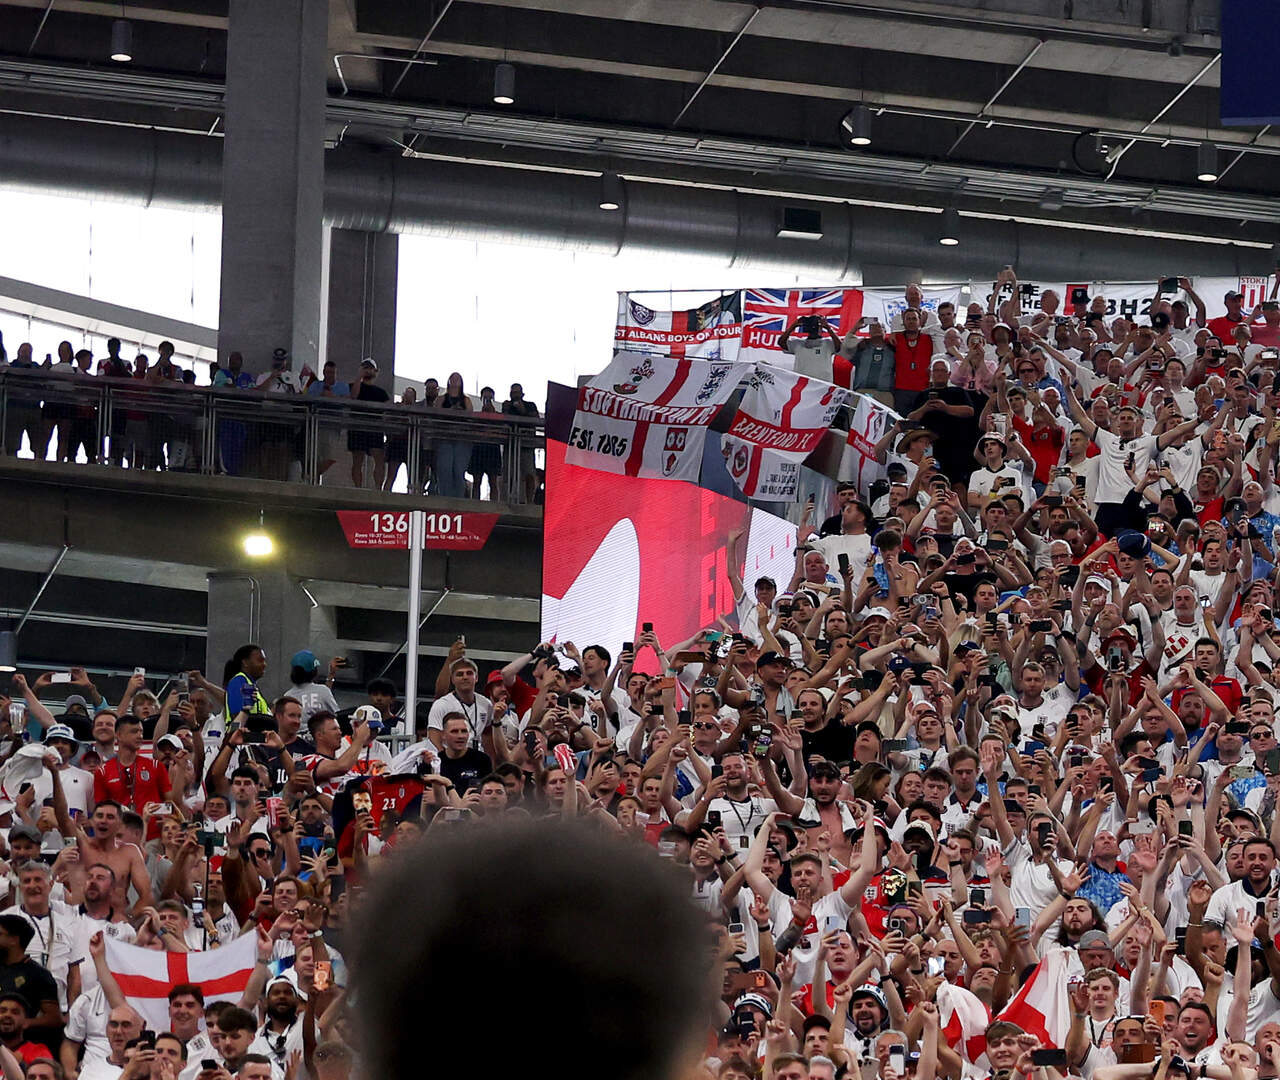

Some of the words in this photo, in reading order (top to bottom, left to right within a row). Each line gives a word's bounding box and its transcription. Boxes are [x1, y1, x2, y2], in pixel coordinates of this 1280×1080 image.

[629, 330, 666, 342] ALBANS
[668, 335, 694, 343] BOYS
[713, 326, 742, 337] TOUR
[583, 388, 695, 424] SOUTHAMPTON
[690, 405, 716, 425] FC
[568, 427, 594, 452] EST.
[732, 416, 799, 449] BRENTFORD
[370, 513, 408, 533] 136
[427, 514, 462, 533] 101
[382, 798, 396, 811] 23
